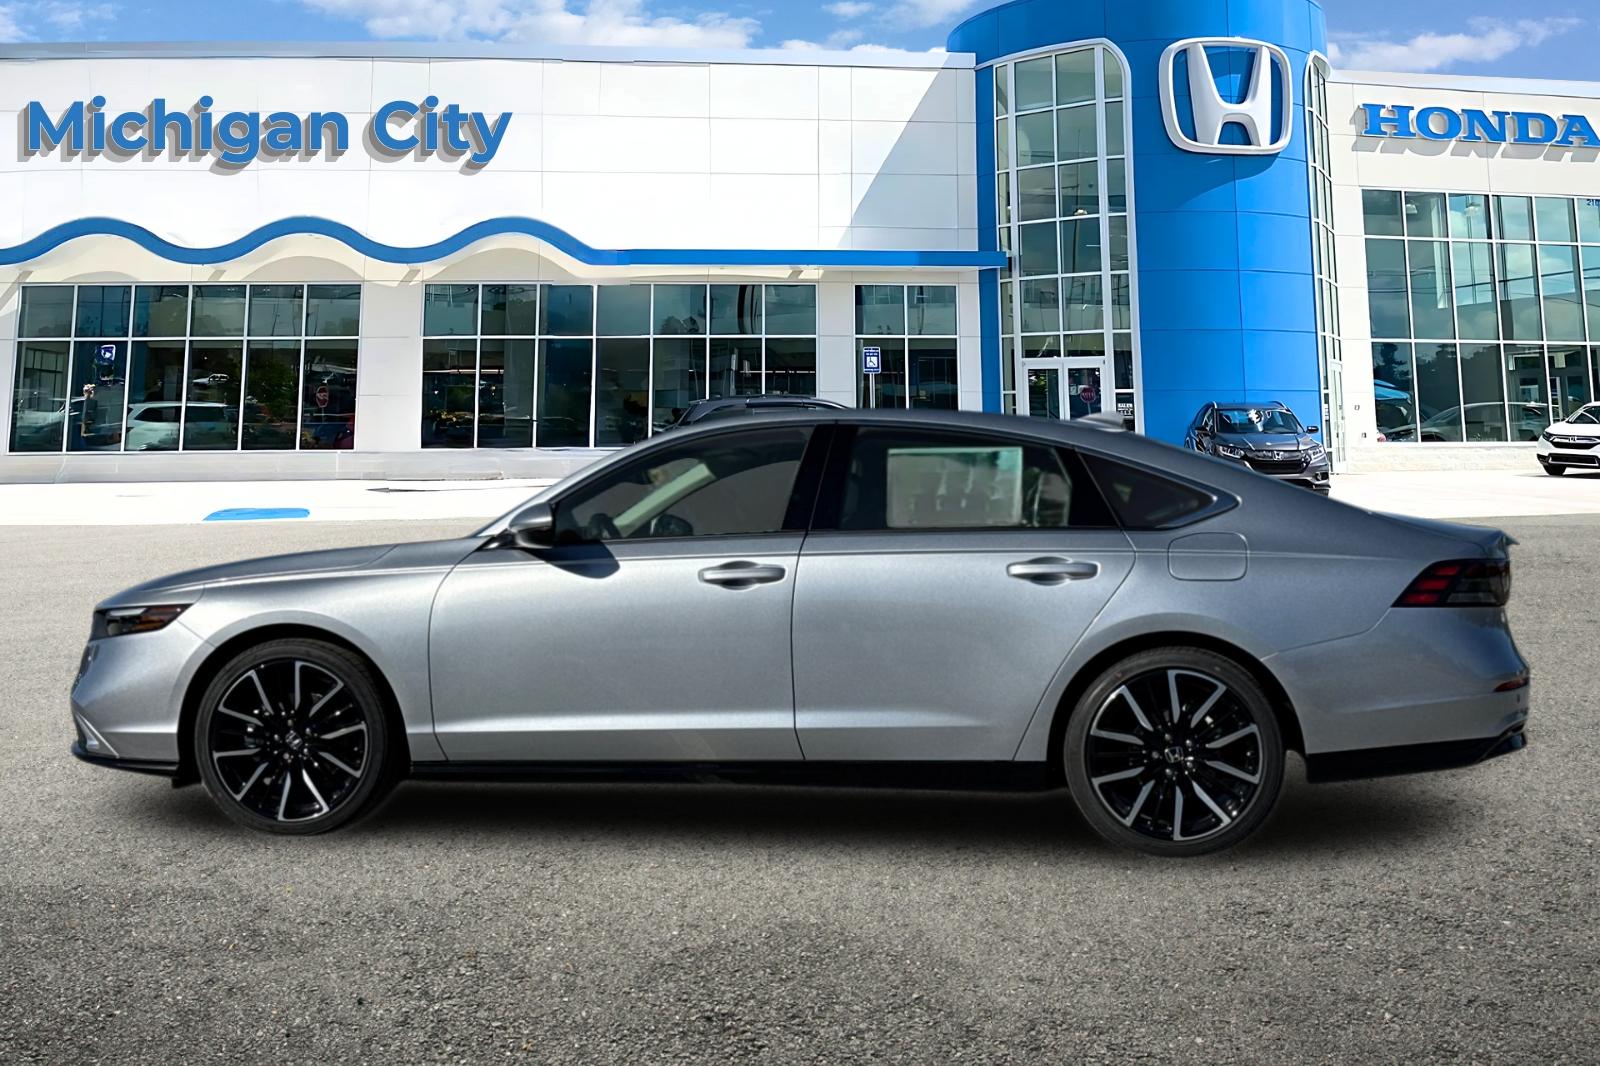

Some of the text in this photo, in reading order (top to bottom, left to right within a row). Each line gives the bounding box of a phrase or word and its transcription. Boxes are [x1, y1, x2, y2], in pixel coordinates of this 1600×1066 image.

[28, 95, 513, 164] Michigan City
[1361, 103, 1600, 147] HONDA
